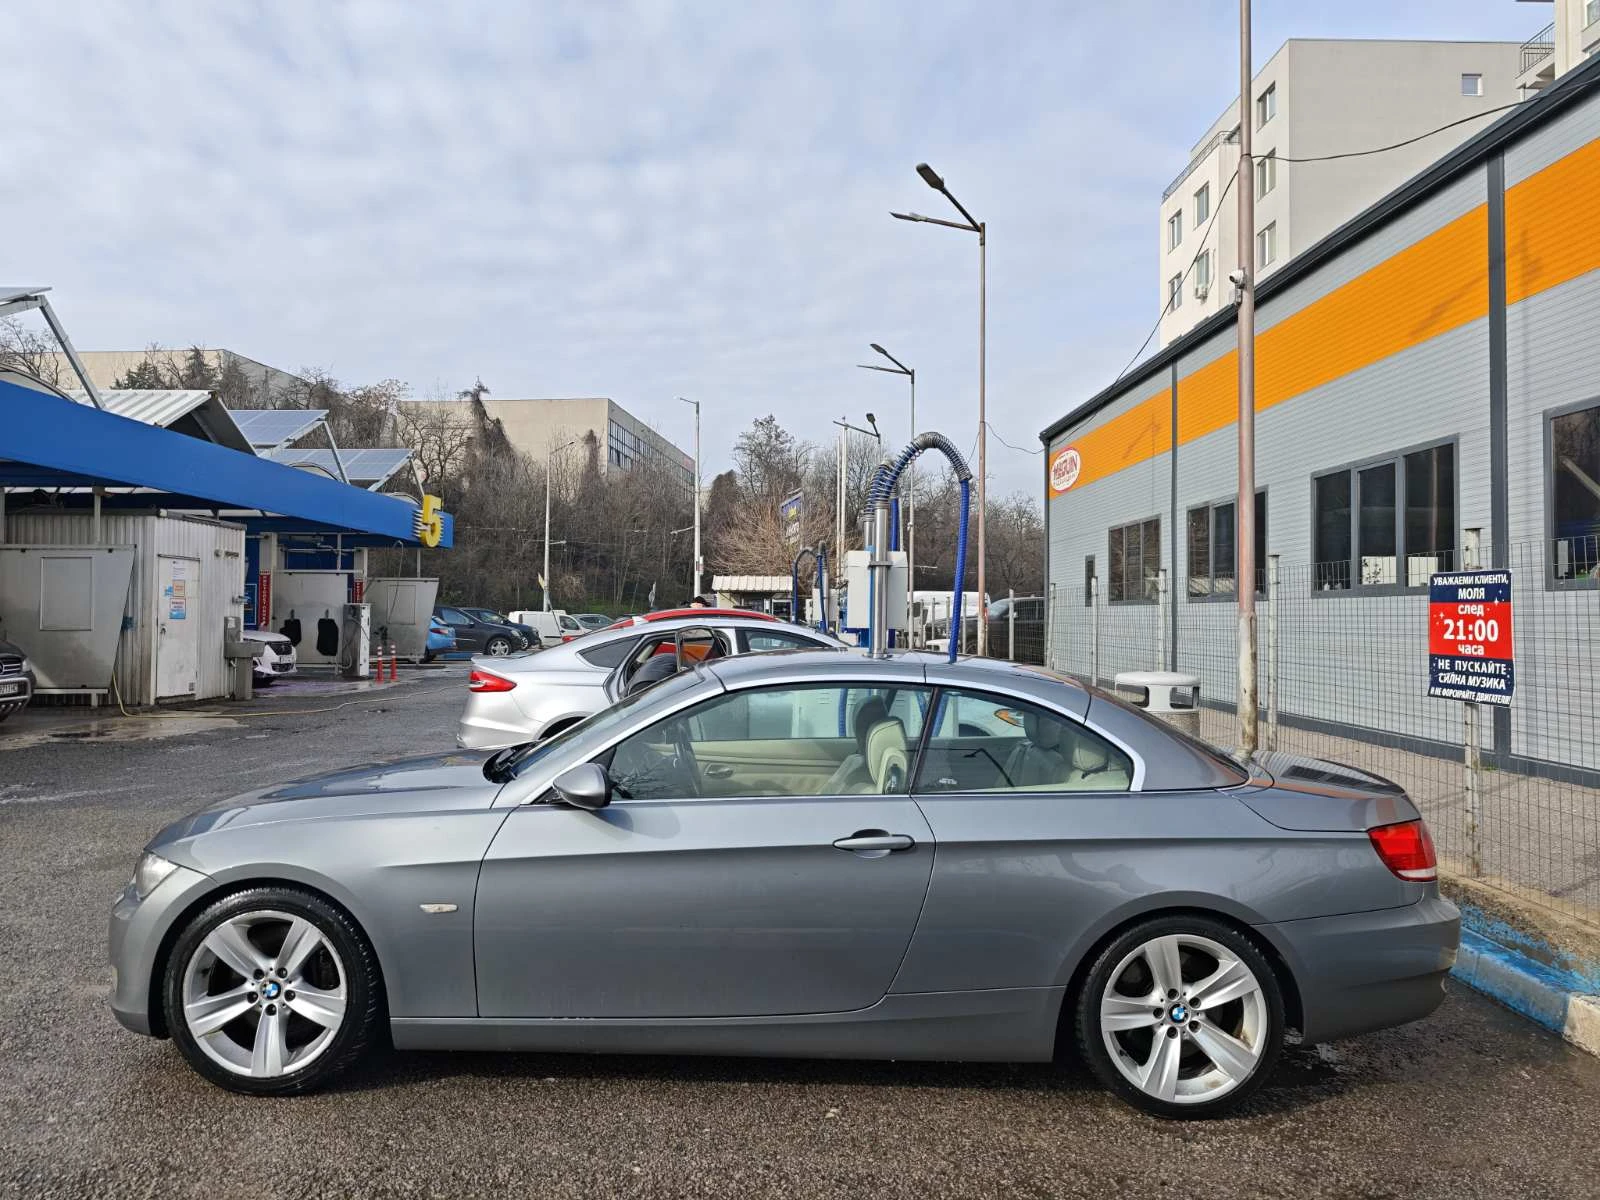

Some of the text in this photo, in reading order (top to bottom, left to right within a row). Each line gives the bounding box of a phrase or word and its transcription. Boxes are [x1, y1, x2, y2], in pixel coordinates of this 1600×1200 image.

[420, 495, 442, 547] 5
[1433, 574, 1509, 586] УВАЖАЕМИ КЛИЕНТИ,
[1458, 588, 1485, 600] МОЛЯ
[1458, 604, 1484, 616] след
[1443, 619, 1499, 642] 21:00
[1458, 644, 1484, 655] часа
[1438, 659, 1507, 675] НЕ ПУСКАЙТЕ
[1438, 673, 1506, 690] СИЛНА МУЗИКА
[1435, 687, 1442, 695] НЕ
